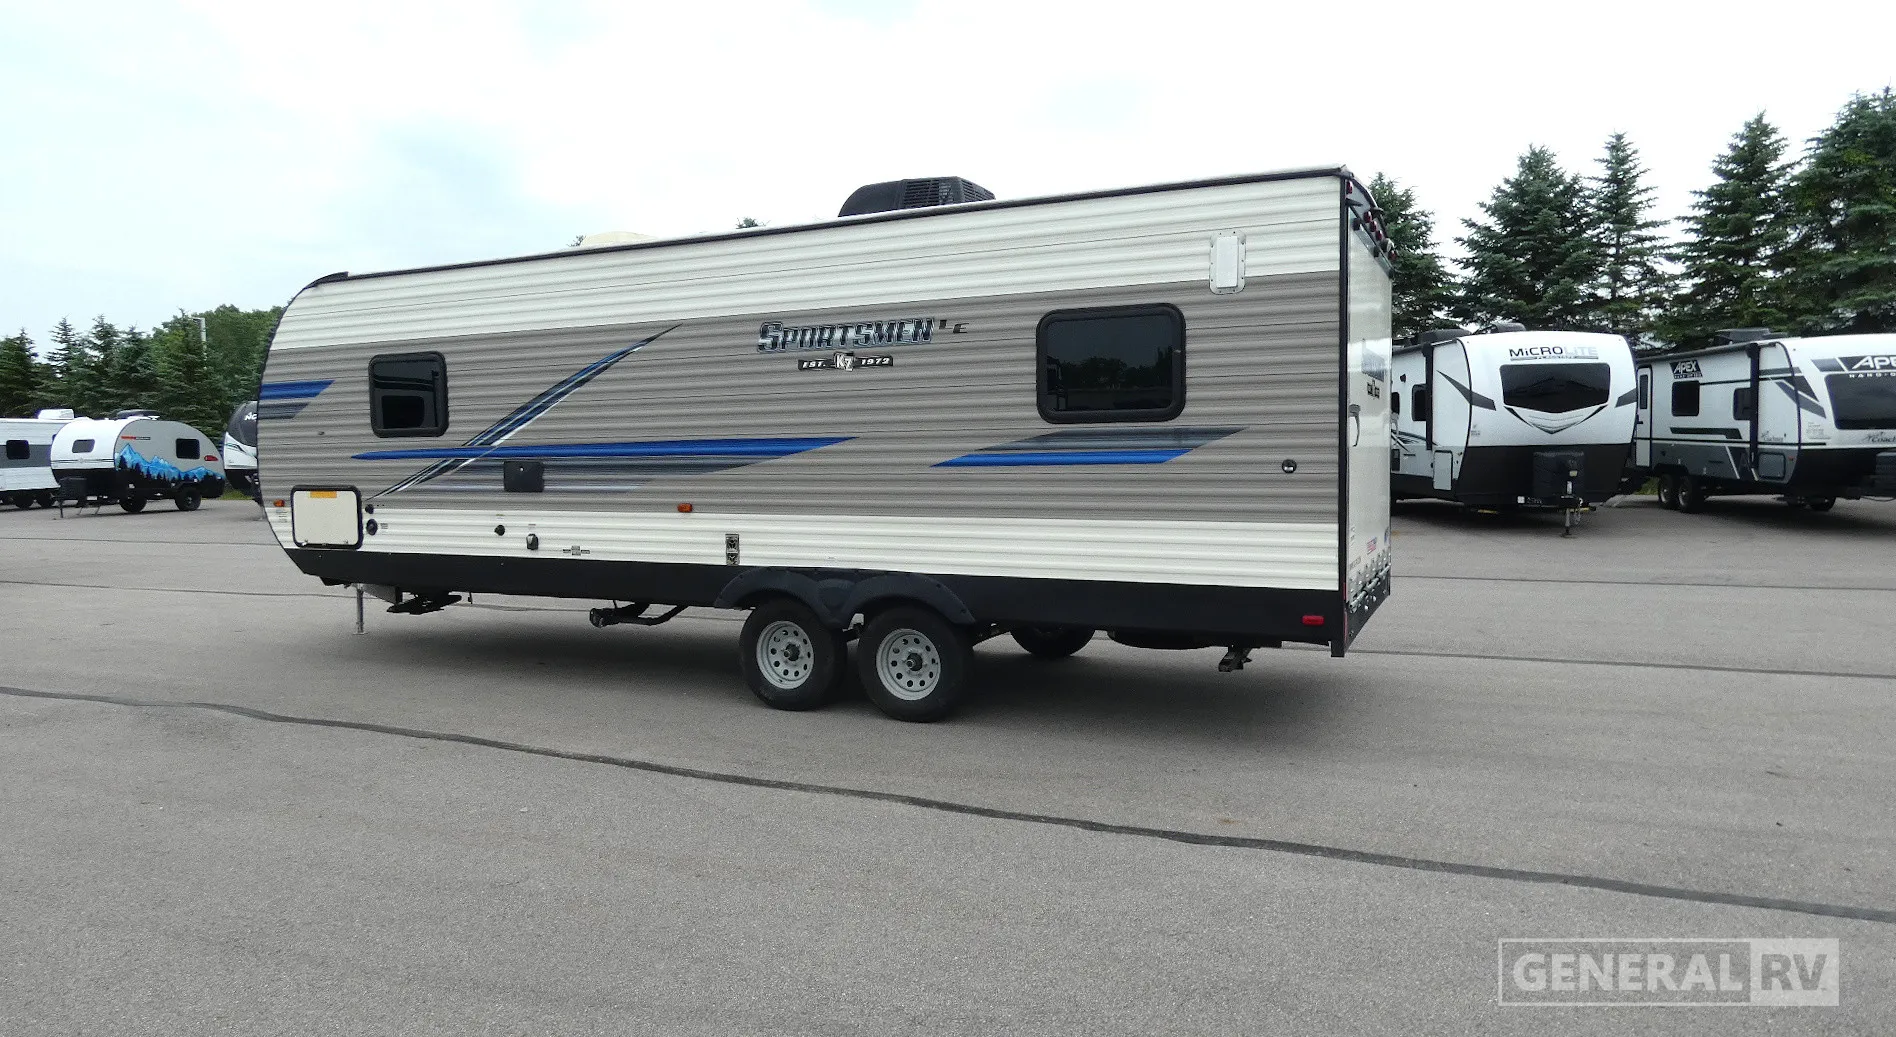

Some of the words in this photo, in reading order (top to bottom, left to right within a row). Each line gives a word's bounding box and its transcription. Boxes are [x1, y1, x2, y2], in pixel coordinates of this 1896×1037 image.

[939, 319, 969, 334] LE
[802, 361, 827, 369] EST.
[835, 352, 854, 372] KZ
[861, 357, 891, 366] 1972
[1674, 361, 1697, 374] APEX
